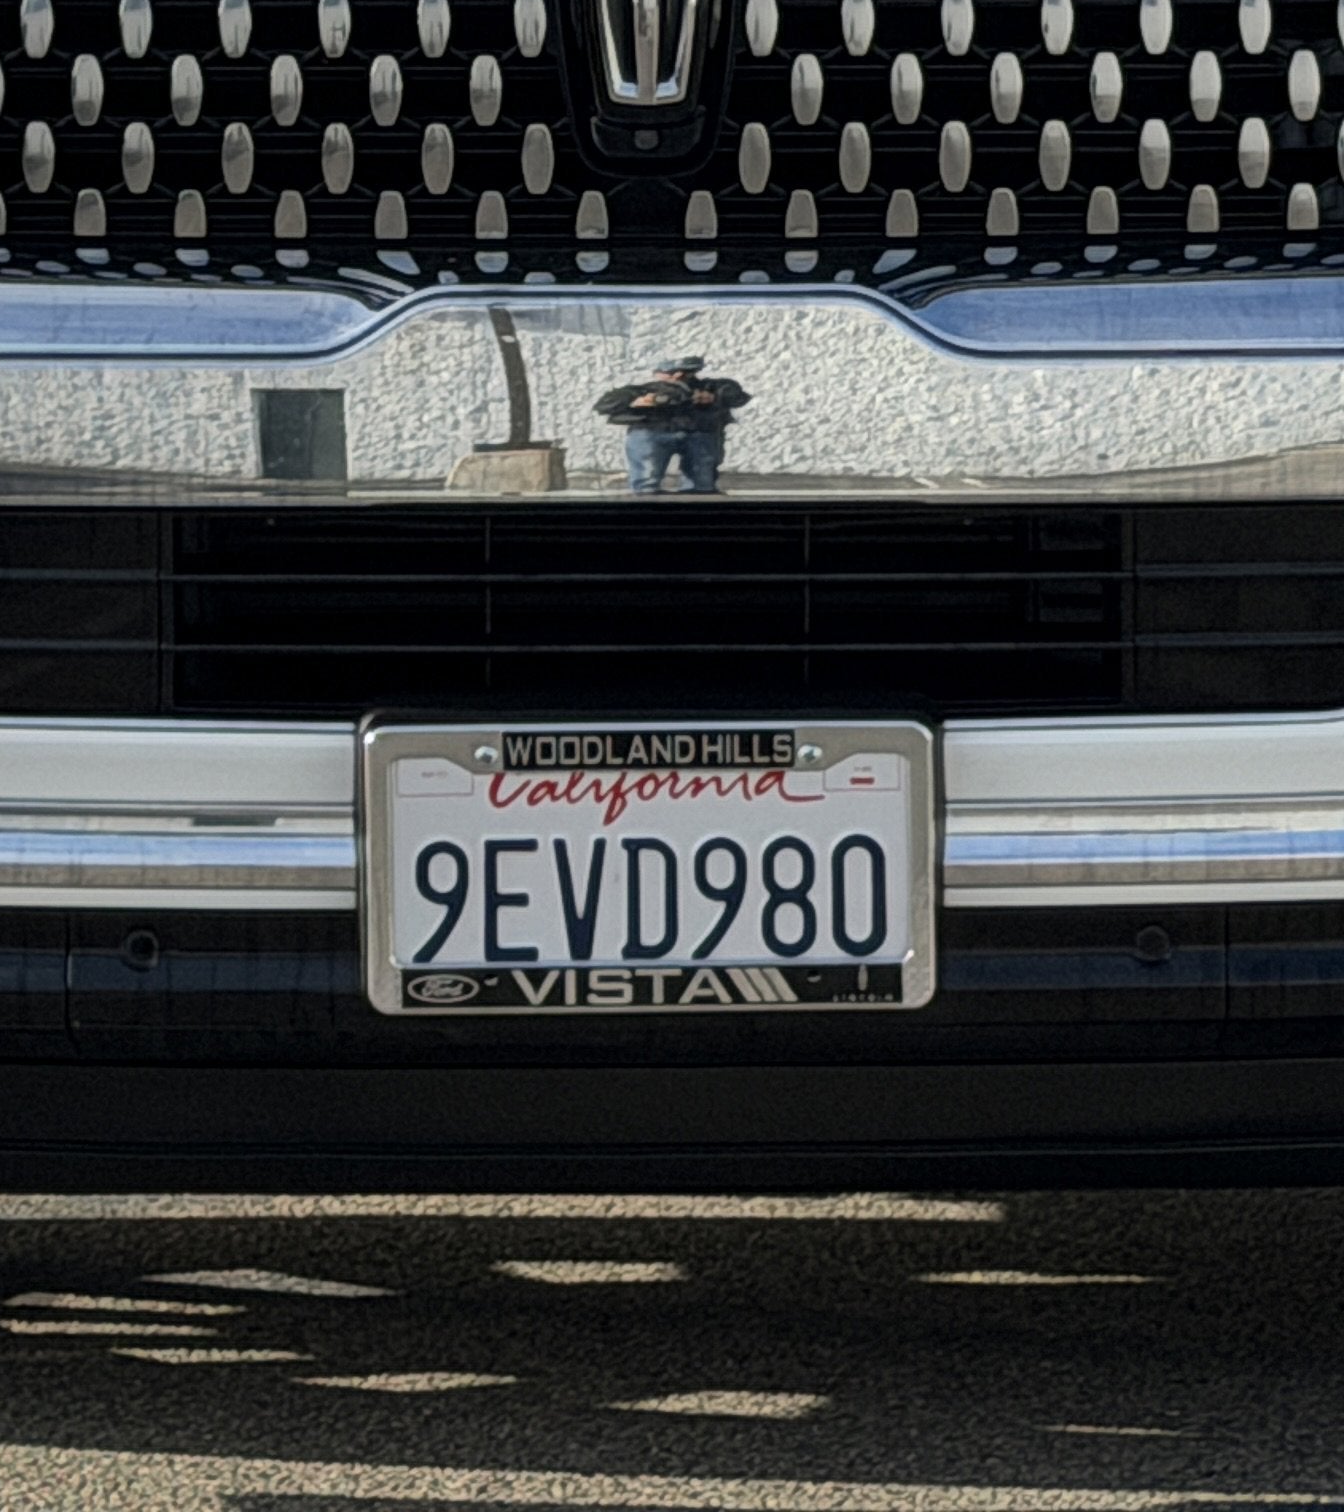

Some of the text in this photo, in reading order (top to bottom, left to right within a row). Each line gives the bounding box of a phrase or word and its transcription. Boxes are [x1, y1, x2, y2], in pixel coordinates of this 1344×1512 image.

[487, 771, 825, 825] California
[412, 834, 888, 963] 9EVD980
[510, 969, 735, 1005] VISTA
